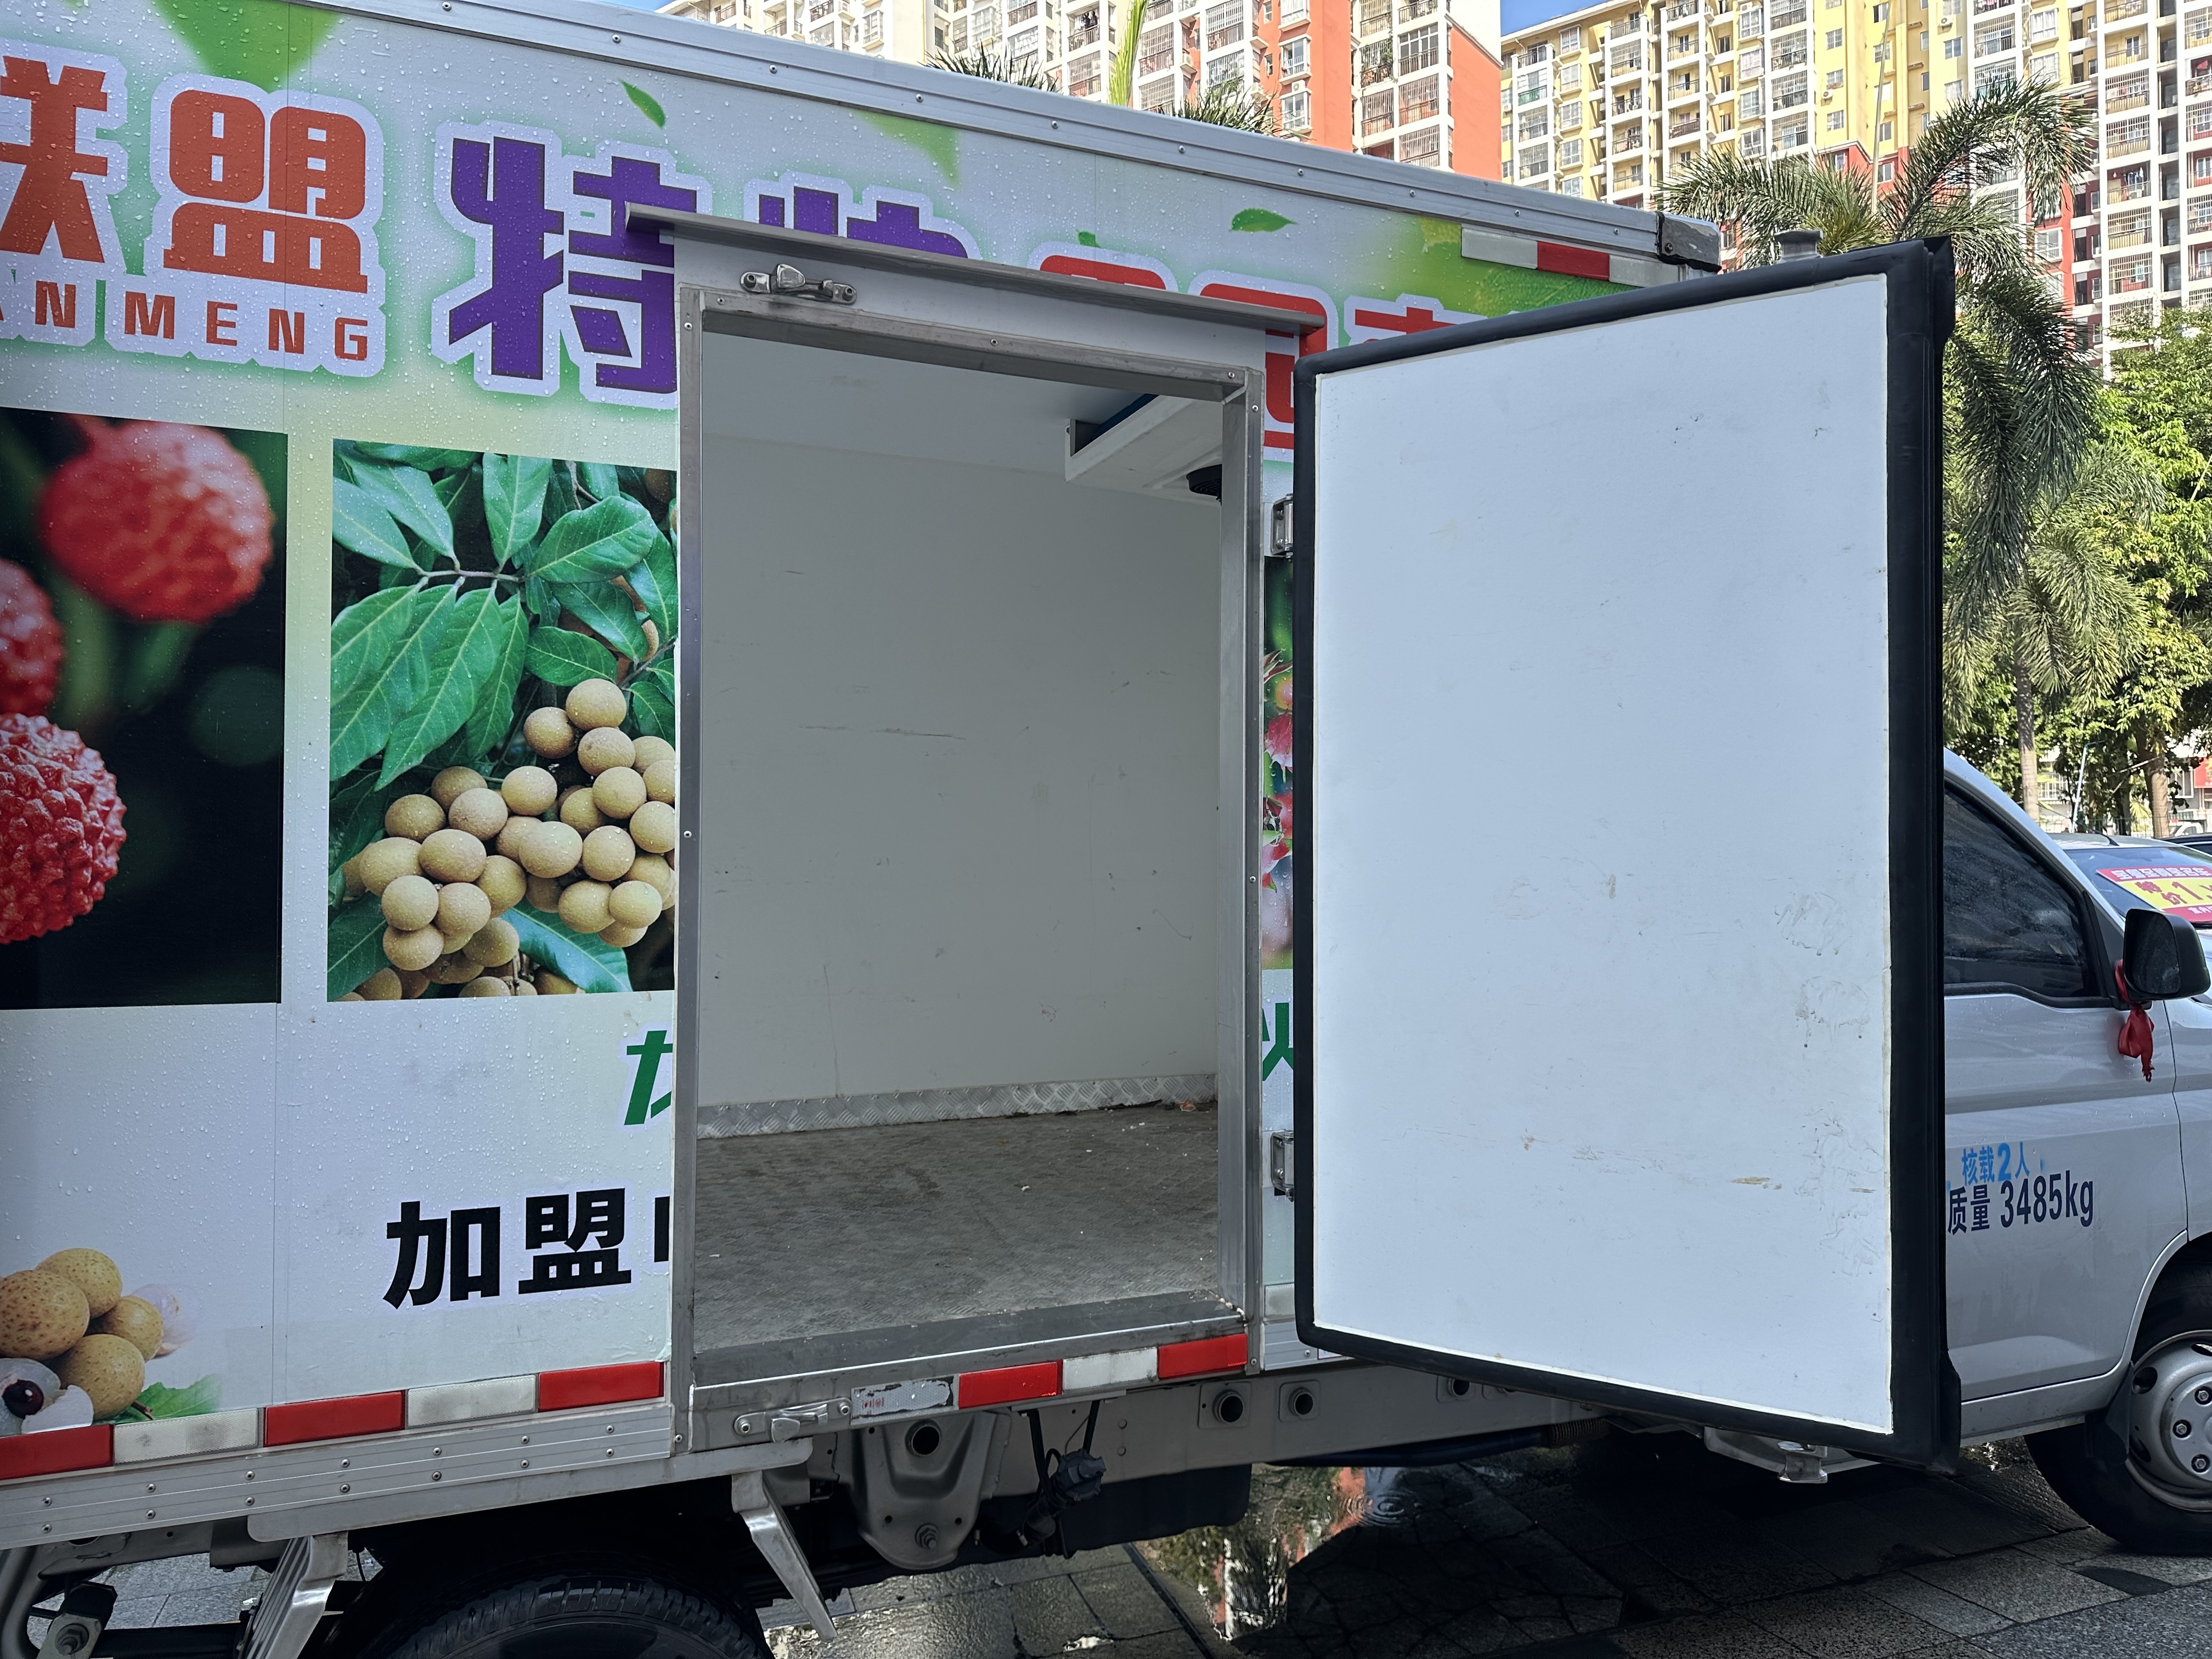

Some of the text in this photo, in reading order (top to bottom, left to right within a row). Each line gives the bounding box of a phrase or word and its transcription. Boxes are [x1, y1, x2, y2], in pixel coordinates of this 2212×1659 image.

[124, 292, 368, 362] MENG
[1961, 1142, 2030, 1186] 核载2人
[1948, 1170, 2094, 1235] 质量 3485kg
[382, 1188, 670, 1310] 加盟
